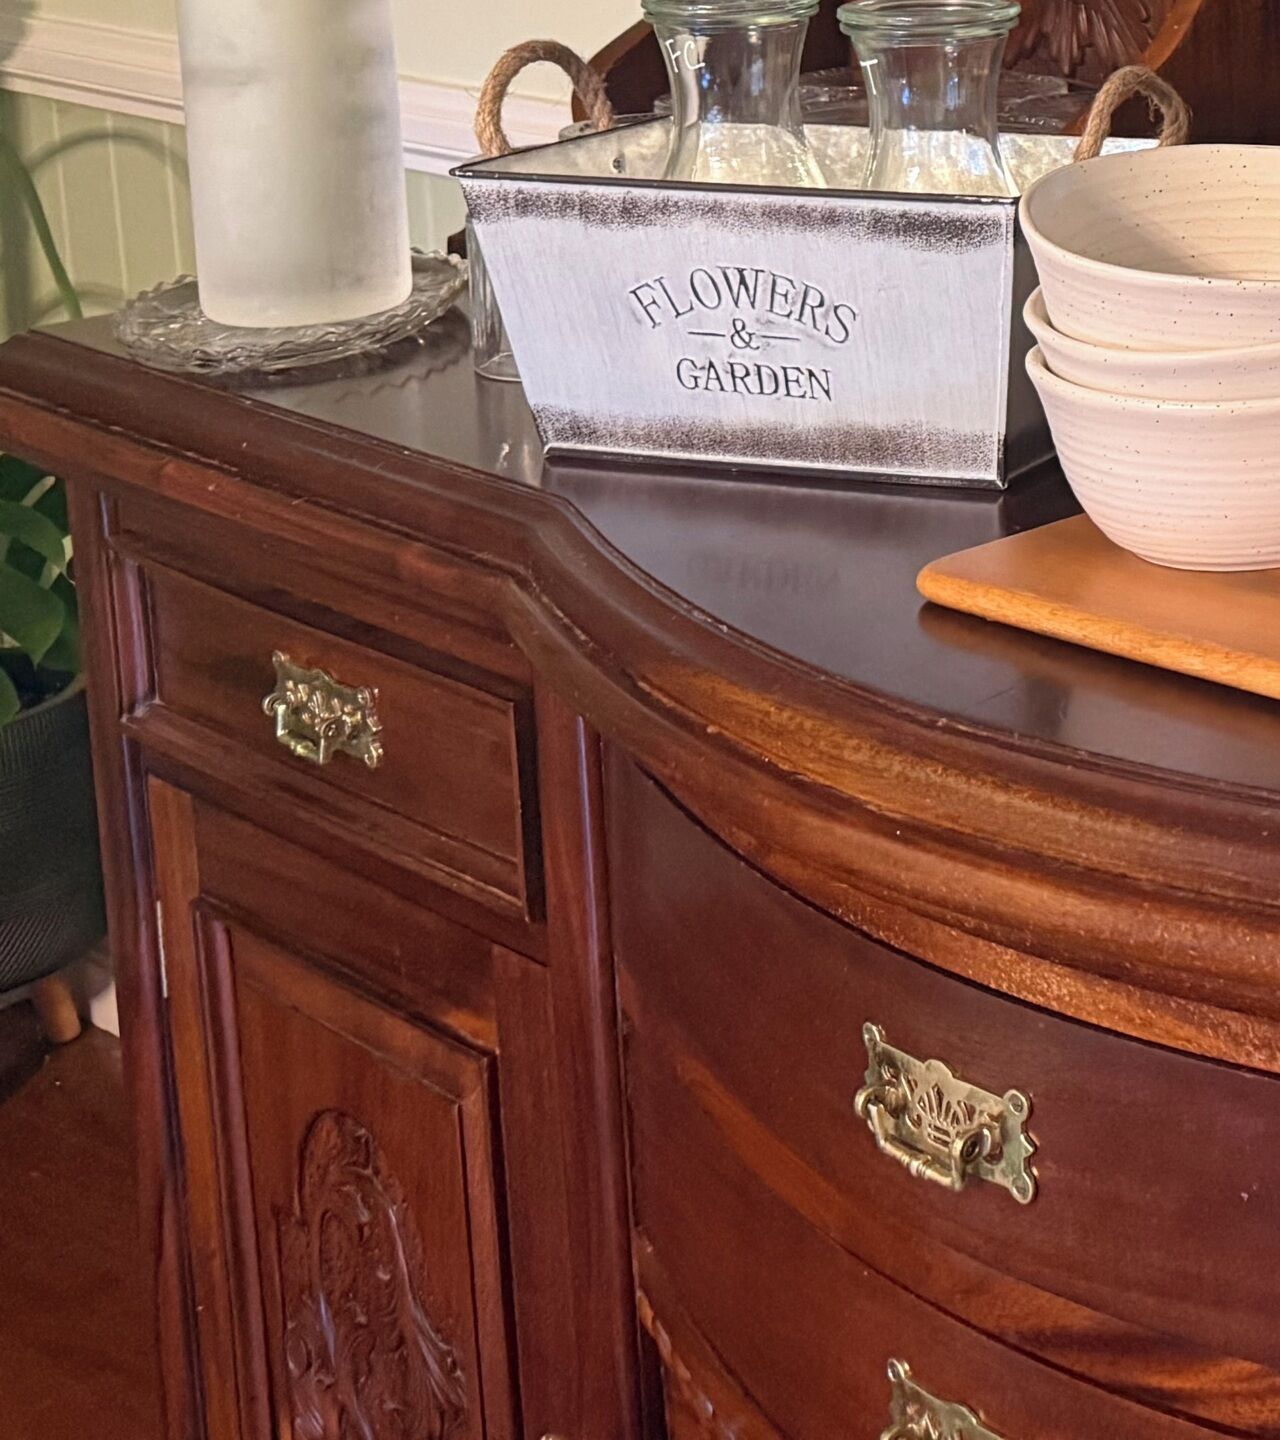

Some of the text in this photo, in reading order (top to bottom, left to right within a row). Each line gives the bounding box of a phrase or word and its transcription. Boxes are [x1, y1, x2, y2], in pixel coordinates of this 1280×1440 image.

[665, 39, 706, 73] FC
[629, 265, 857, 344] FLOWERS
[730, 318, 760, 350] &
[676, 358, 832, 401] GARDEN
